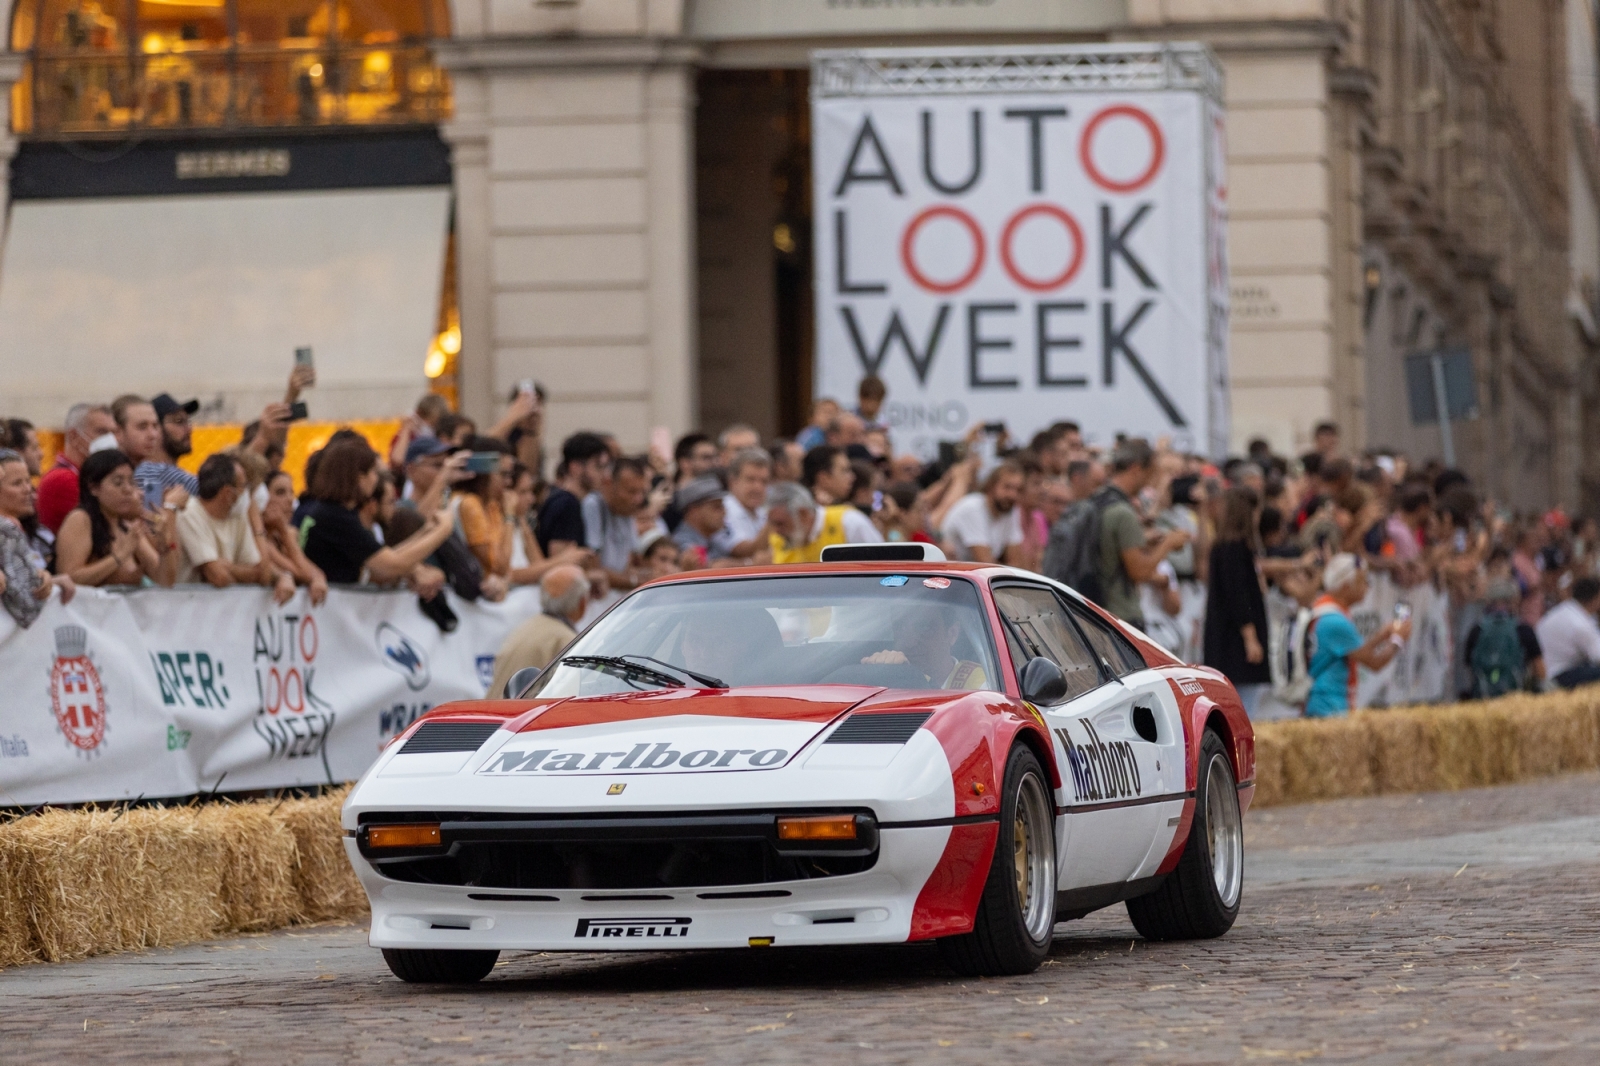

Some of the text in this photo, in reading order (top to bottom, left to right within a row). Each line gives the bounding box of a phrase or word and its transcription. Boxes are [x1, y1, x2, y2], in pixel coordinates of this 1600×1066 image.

[833, 102, 1166, 196] AUTO
[834, 201, 1162, 295] LOOK
[839, 299, 1187, 427] WEEK
[253, 614, 319, 663] AUTO
[255, 666, 332, 717] LOOK
[1171, 676, 1205, 696] PIRELLI
[253, 711, 335, 786] WEEK
[479, 742, 789, 774] Marlboro
[1053, 717, 1142, 802] Marlboro
[574, 917, 693, 938] PIRELLI
